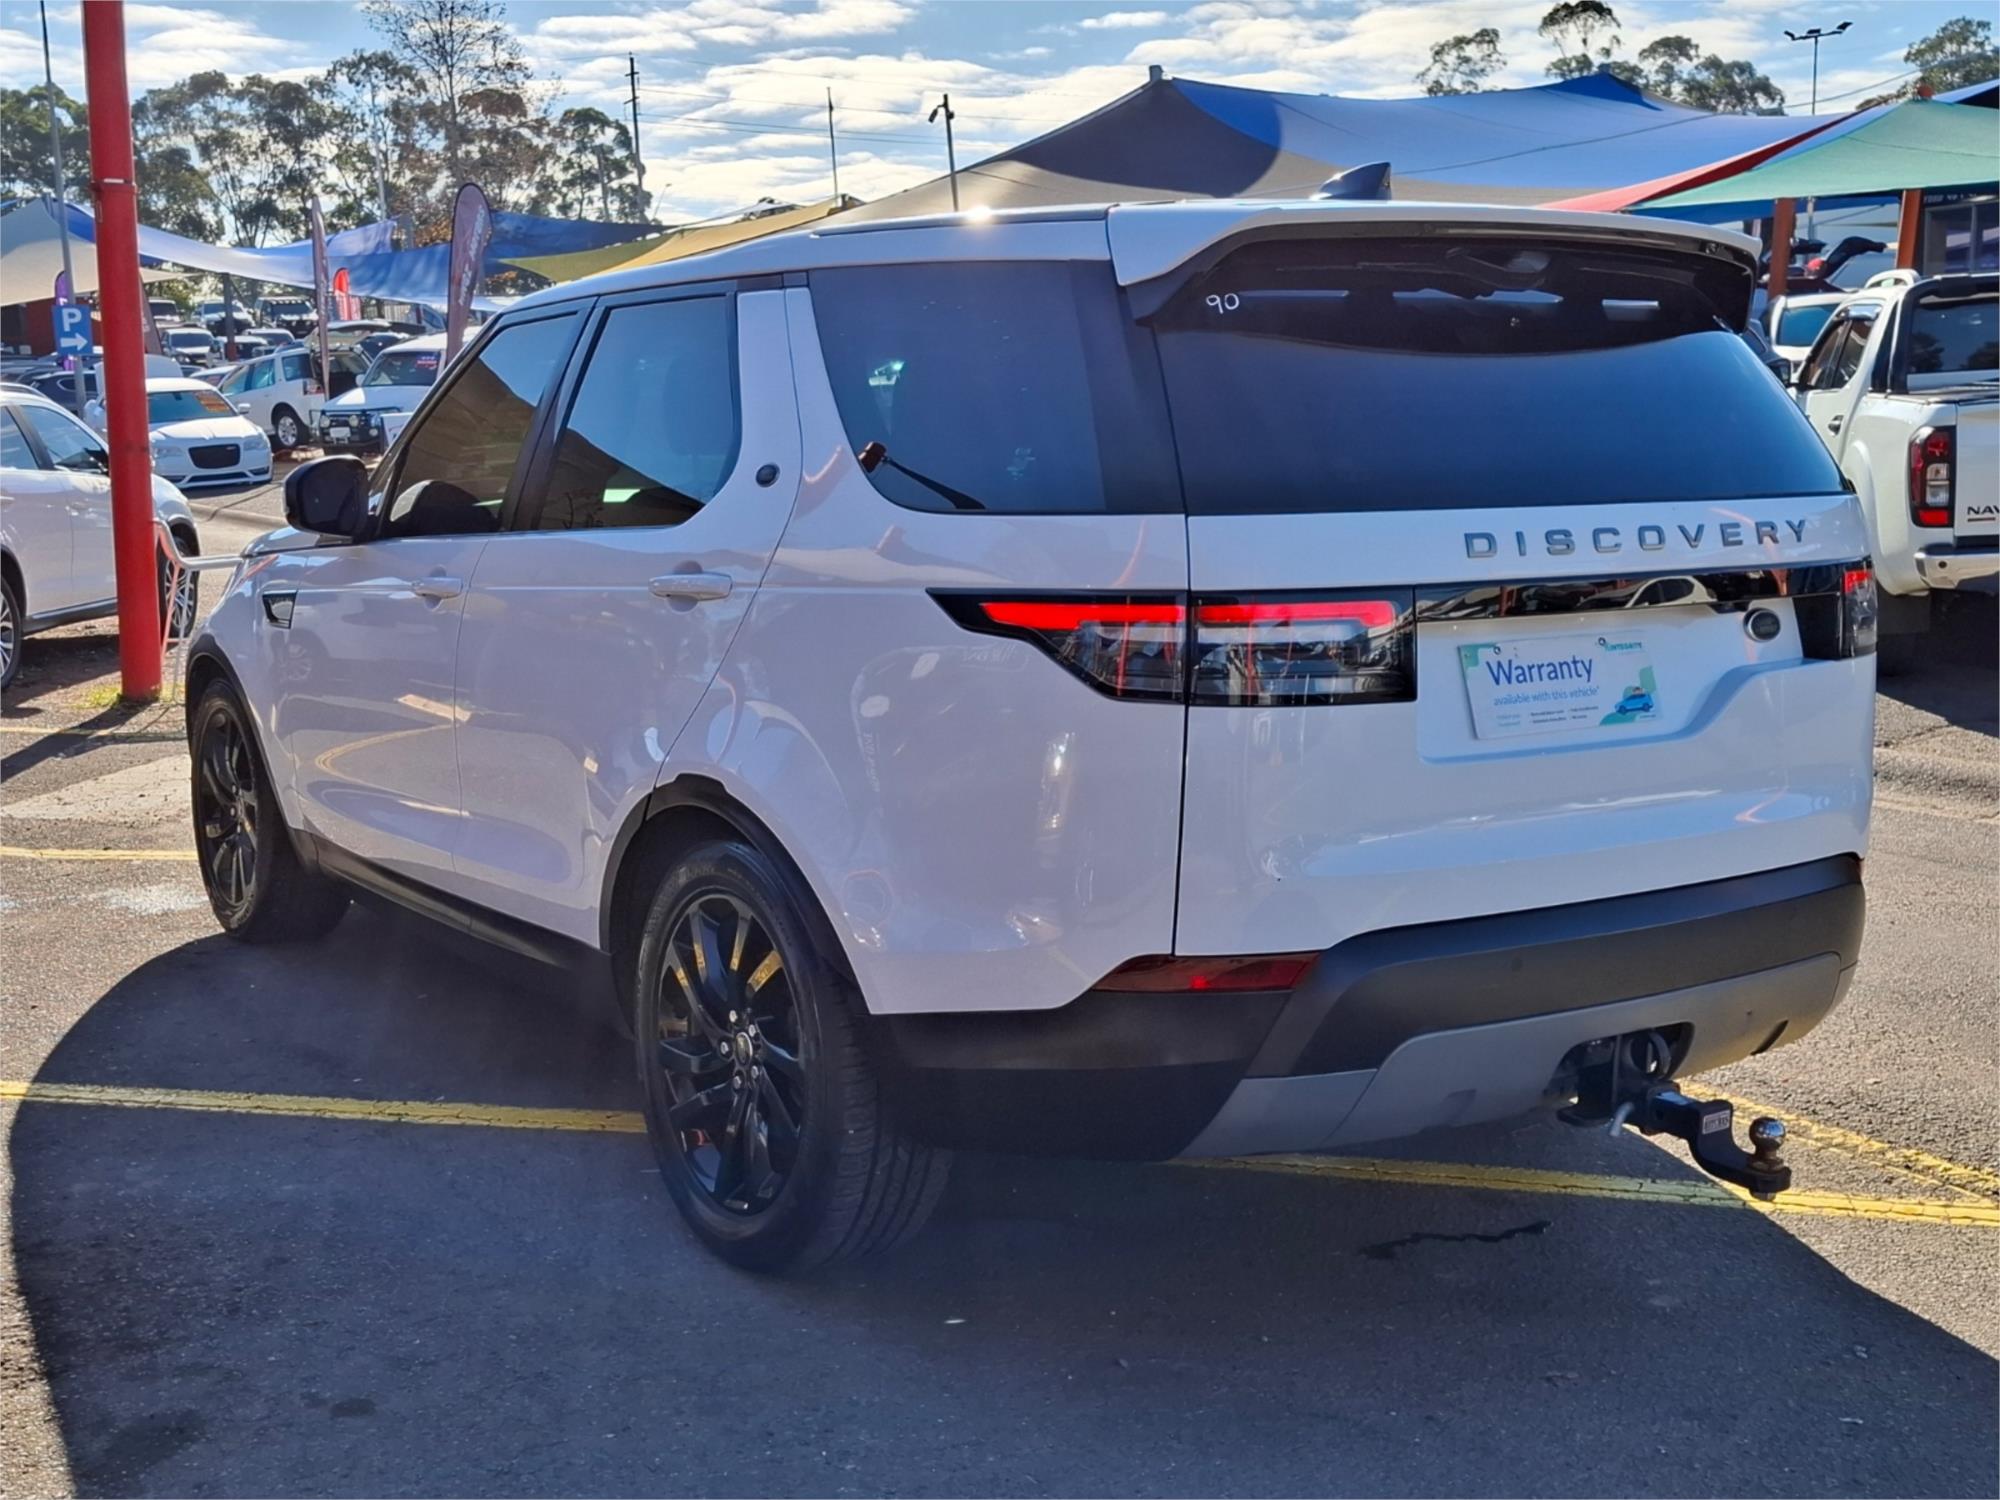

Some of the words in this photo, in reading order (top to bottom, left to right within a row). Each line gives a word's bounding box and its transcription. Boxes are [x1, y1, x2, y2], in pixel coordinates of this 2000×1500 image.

[1206, 293, 1239, 314] 90
[62, 307, 82, 332] P
[1464, 519, 1806, 559] DISCOVERY
[1486, 654, 1593, 686] Warranty
[1494, 692, 1530, 706] available
[1531, 690, 1550, 701] with
[1551, 688, 1568, 700] this
